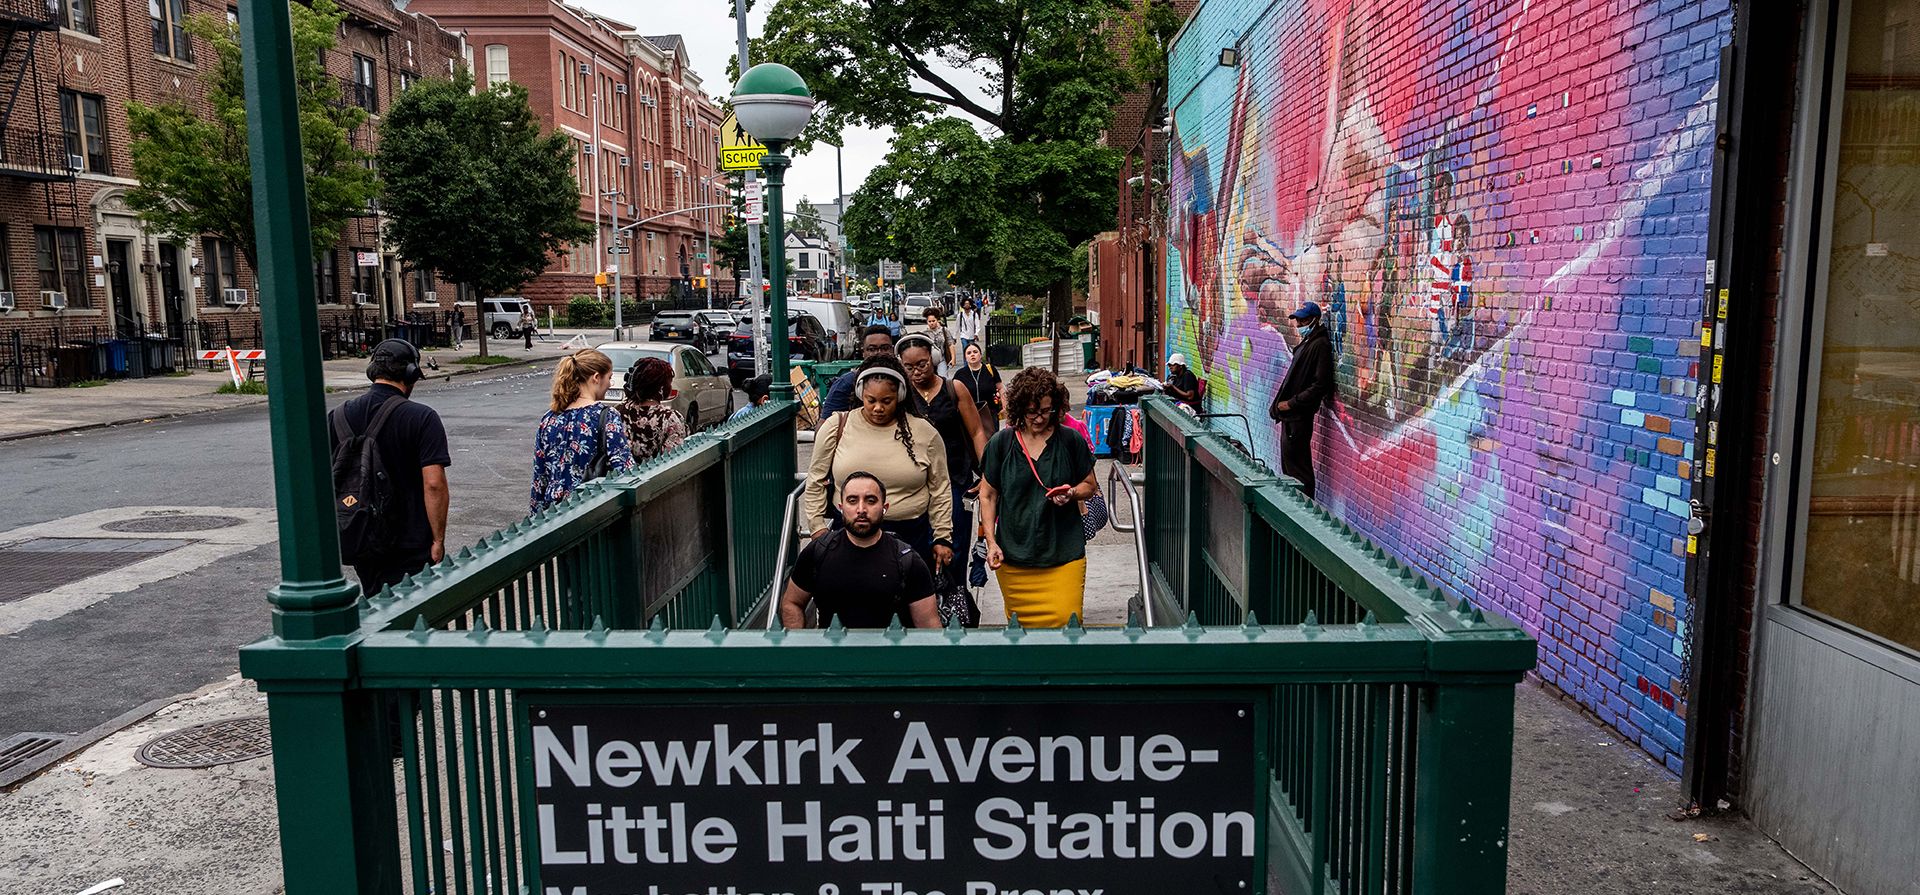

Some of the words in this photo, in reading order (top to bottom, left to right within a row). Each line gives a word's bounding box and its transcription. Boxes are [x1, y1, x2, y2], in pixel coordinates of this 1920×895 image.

[725, 152, 767, 164] SCHOO
[533, 722, 866, 788] Newkirk
[888, 721, 1219, 783] Avenue-
[538, 802, 738, 865] Little
[766, 799, 946, 862] Haiti
[973, 797, 1255, 861] Station
